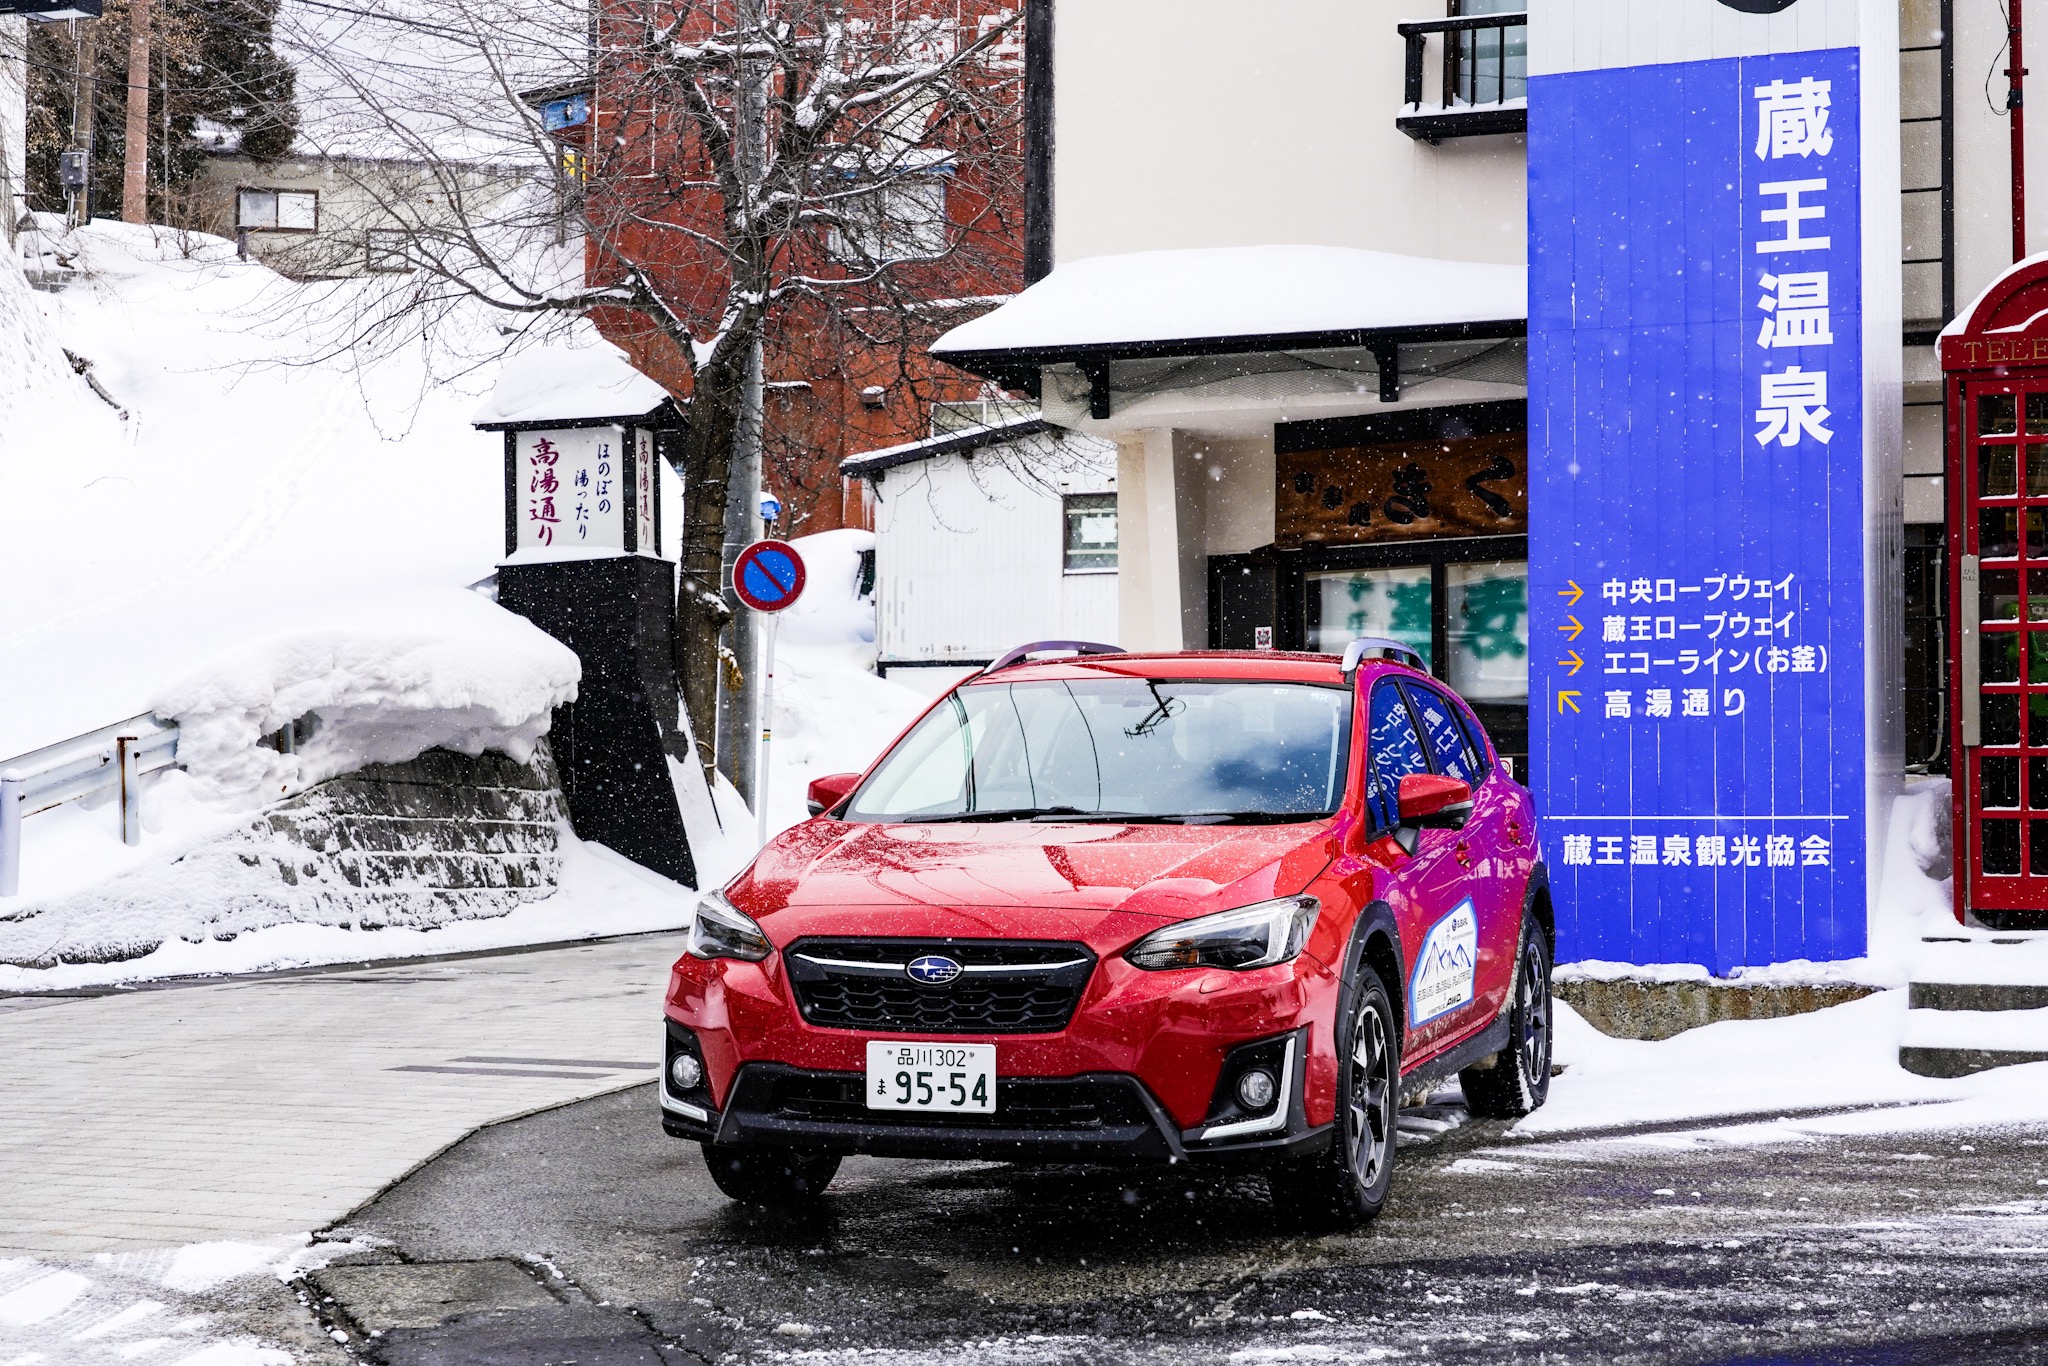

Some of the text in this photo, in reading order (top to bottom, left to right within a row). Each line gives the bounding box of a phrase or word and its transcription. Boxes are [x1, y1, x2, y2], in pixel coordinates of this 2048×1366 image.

[1754, 76, 1834, 447] 蔵王温泉
[529, 438, 561, 546] 高湯通り
[596, 443, 613, 514] ほのぼの
[639, 436, 650, 545] 高湯通り
[574, 469, 589, 540] 湯ったり
[1602, 573, 1795, 605] 中央ロープウェイ
[1602, 610, 1795, 643] 蔵王ロープウェイ
[1603, 645, 1827, 675] エコーライン(お釜)
[1604, 688, 1746, 718] 高湯通り
[1562, 834, 1831, 867] 蔵王温泉観光協会
[877, 1071, 988, 1107] ま 95-54
